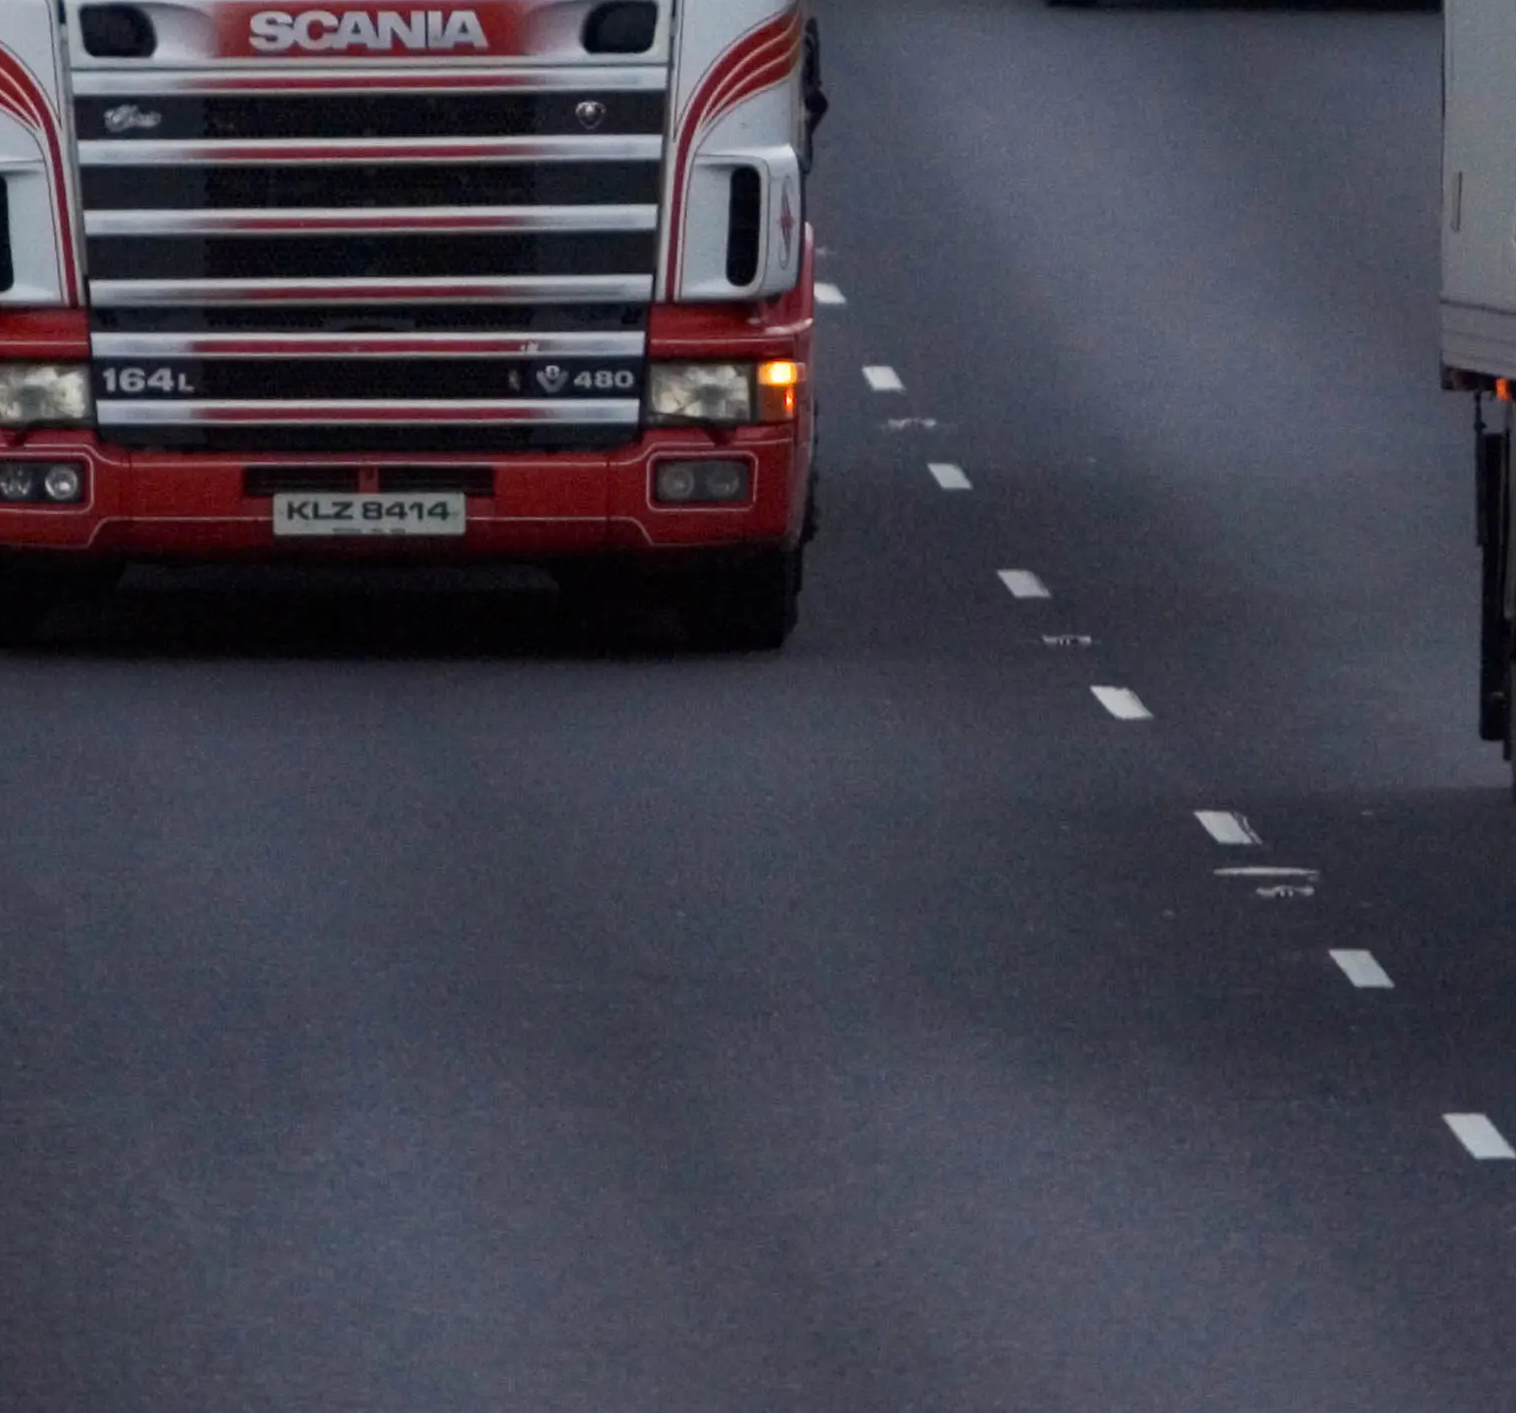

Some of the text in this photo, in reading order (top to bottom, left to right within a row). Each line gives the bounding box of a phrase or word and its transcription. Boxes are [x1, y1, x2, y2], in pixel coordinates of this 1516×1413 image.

[248, 10, 490, 53] SCANIA
[573, 370, 635, 389] 480
[286, 501, 451, 522] KLZ 8414
